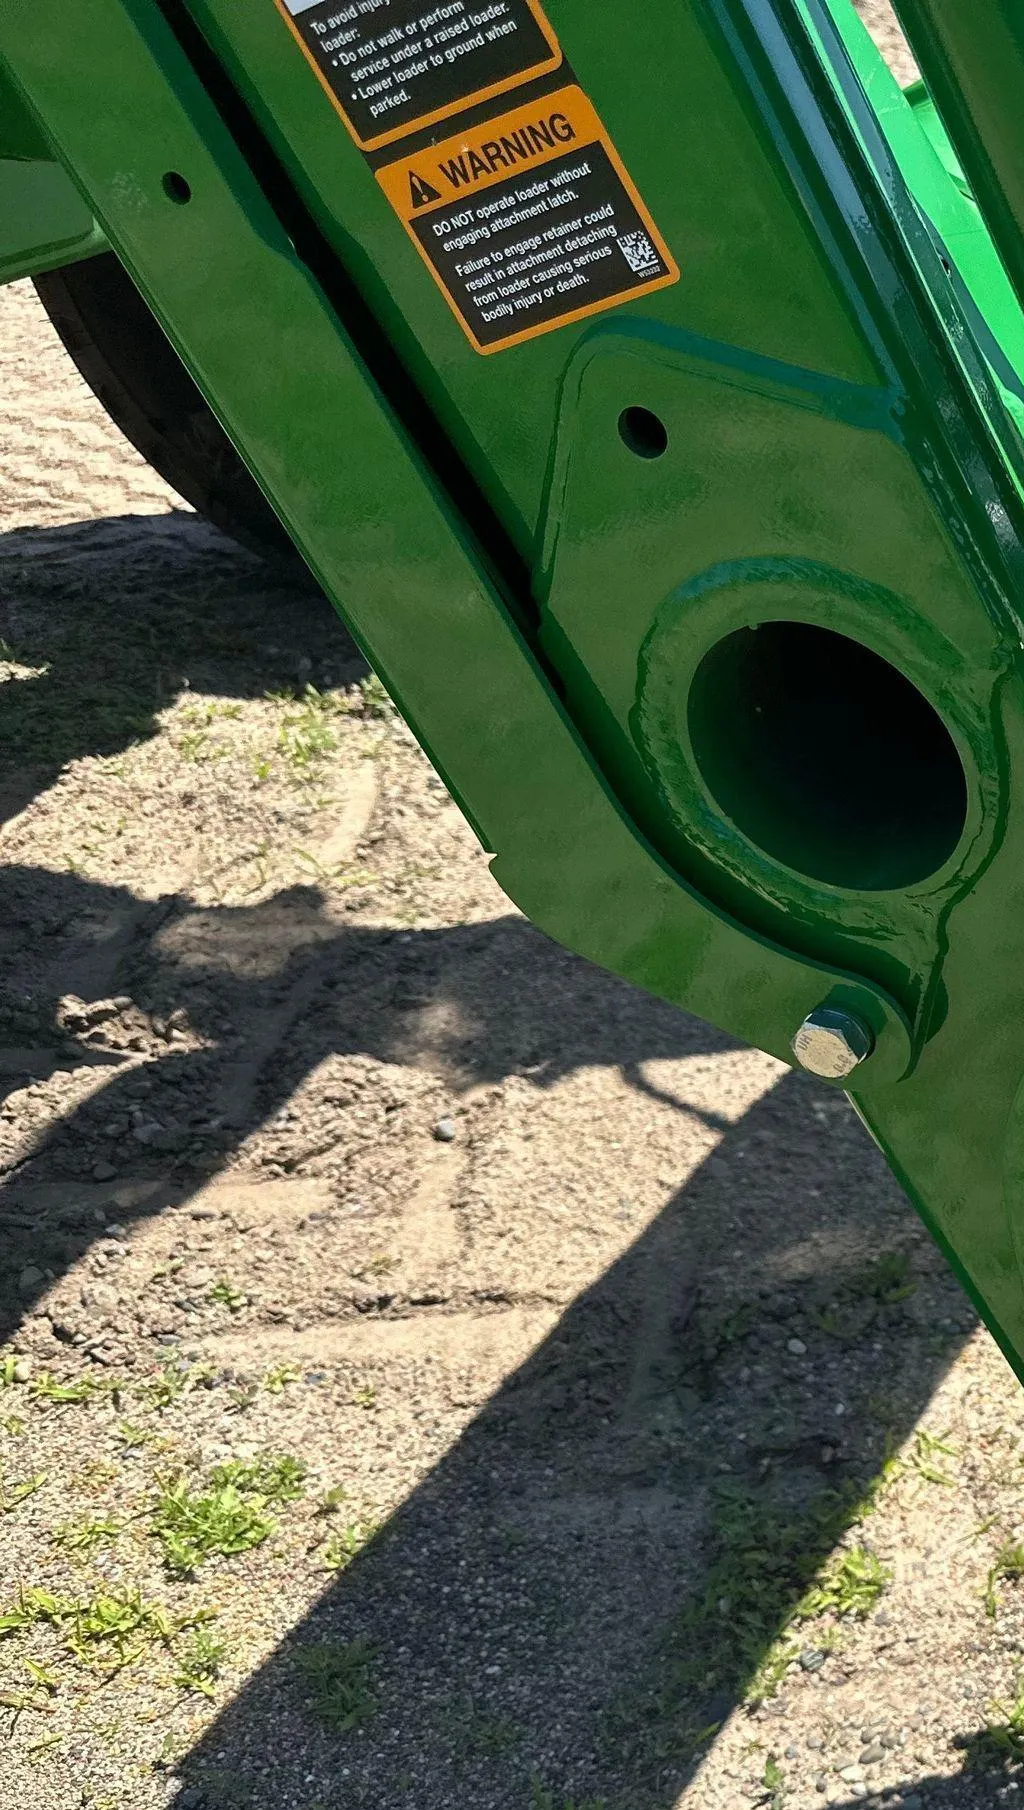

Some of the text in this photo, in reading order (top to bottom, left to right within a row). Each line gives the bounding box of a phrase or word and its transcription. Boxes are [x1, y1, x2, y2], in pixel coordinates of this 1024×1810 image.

[310, 22, 326, 35] To
[328, 8, 358, 29] avoid
[320, 28, 361, 53] loader:
[338, 0, 465, 66] Do not walk or perform
[350, 4, 511, 83] service under a raised loader.
[359, 20, 518, 100] Lower loader to ground when
[369, 90, 412, 118] parked.
[438, 113, 576, 189] WARNING
[432, 162, 592, 237] DO NOT operate loader without
[443, 189, 579, 252] engaging attachment latch.
[454, 203, 614, 277] Failure to engage retainer could
[465, 224, 618, 294] result in attachment detaching
[473, 245, 613, 308] from loader causing serious
[481, 273, 589, 322] bodily injury or death.
